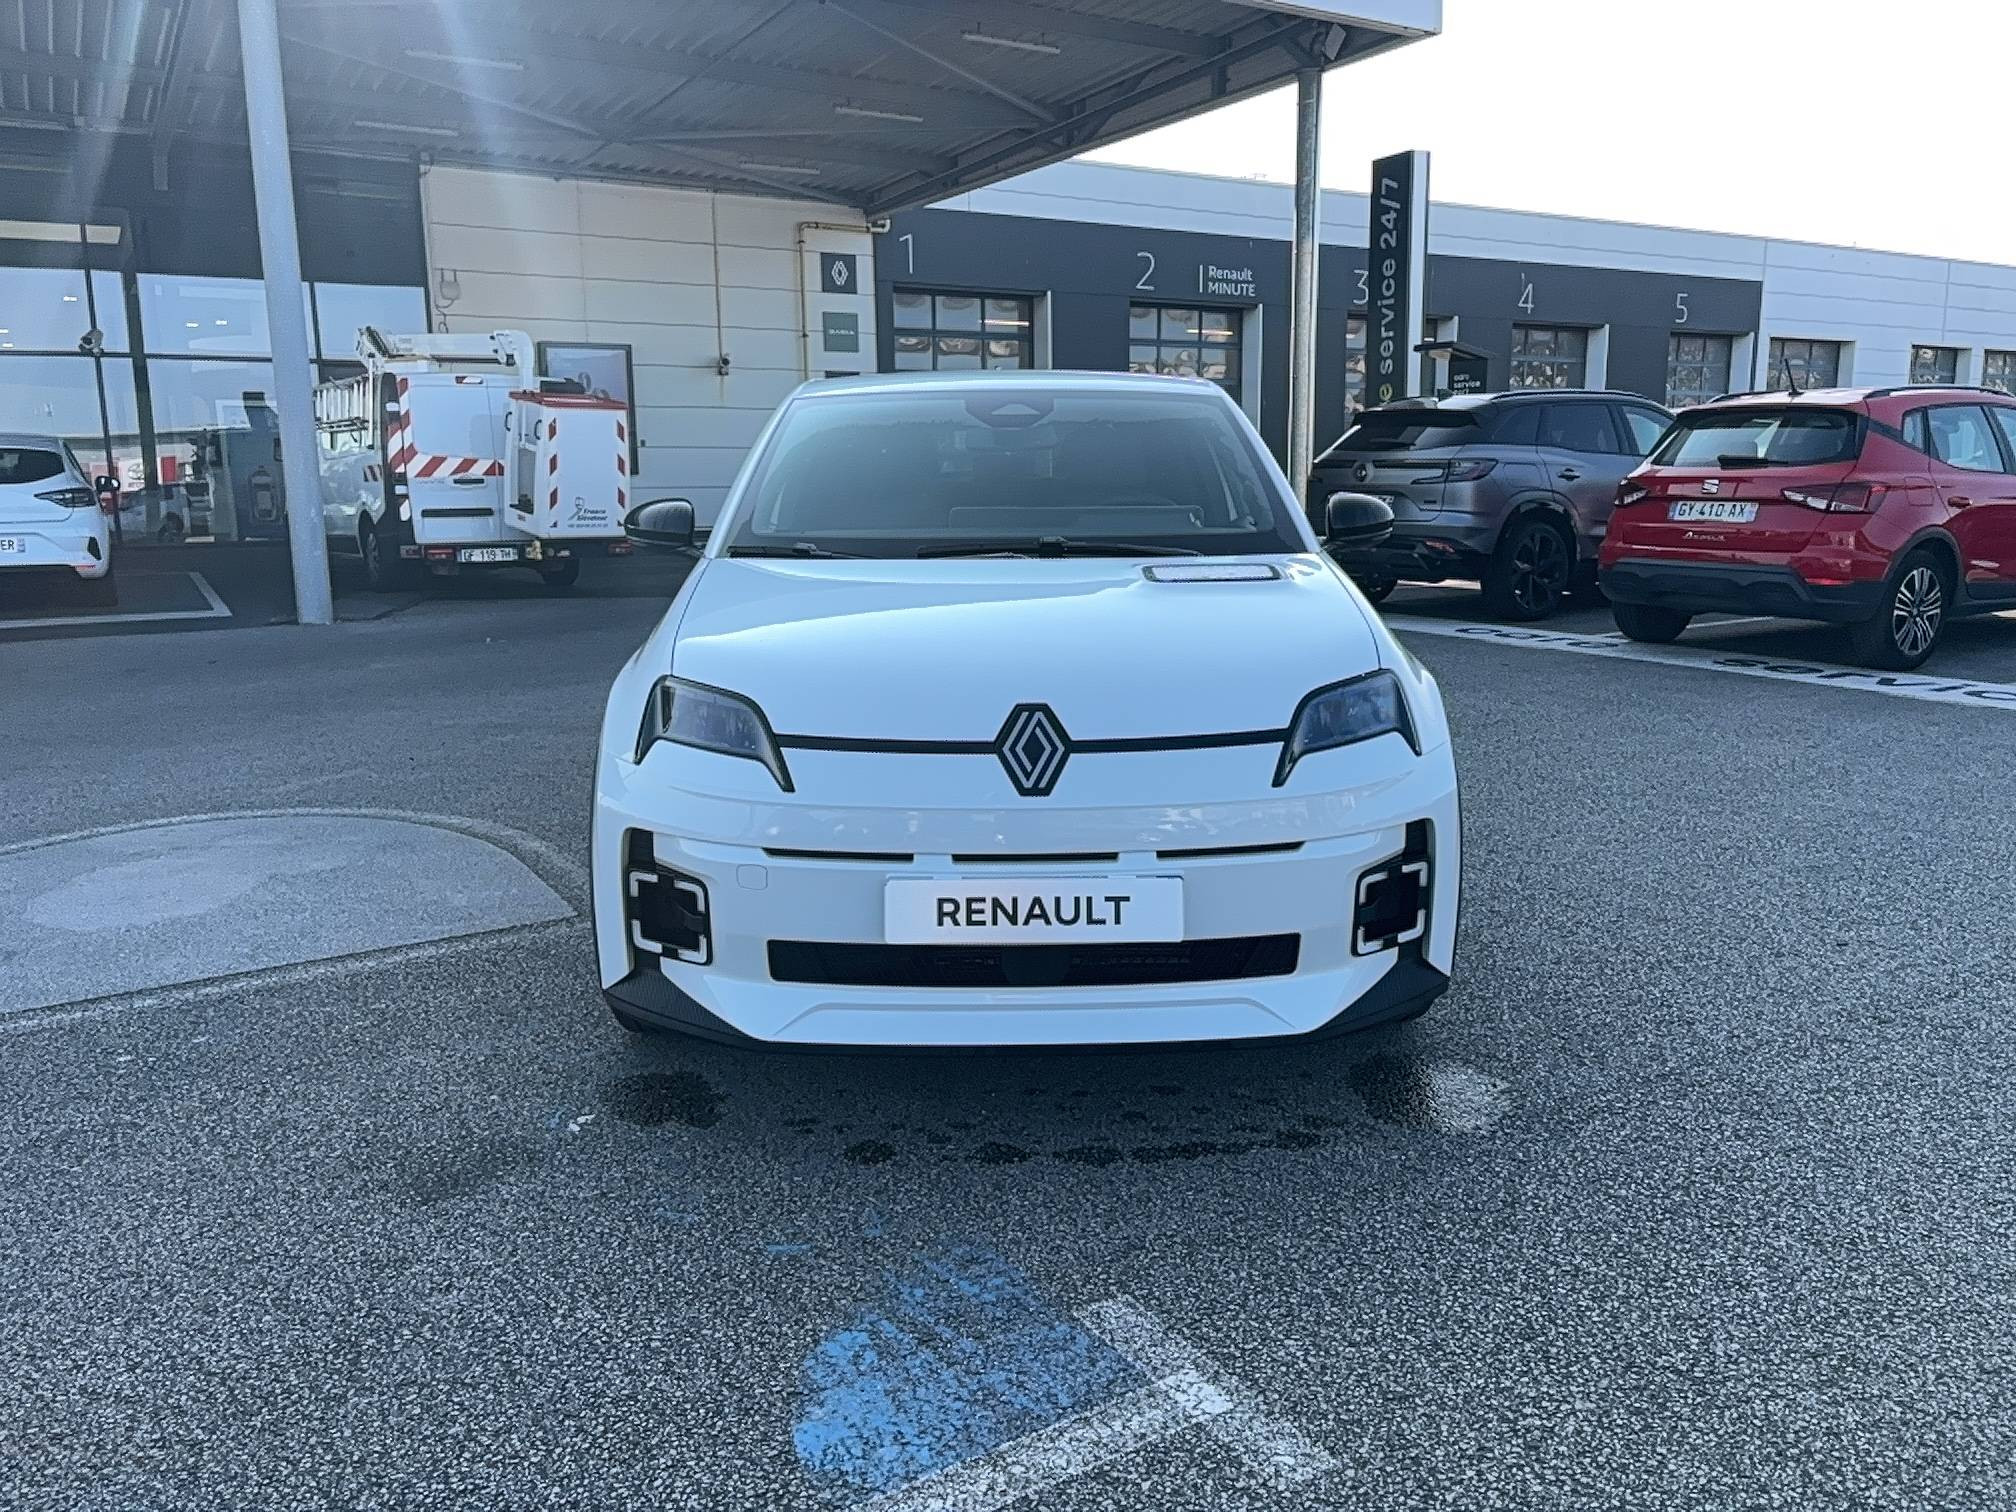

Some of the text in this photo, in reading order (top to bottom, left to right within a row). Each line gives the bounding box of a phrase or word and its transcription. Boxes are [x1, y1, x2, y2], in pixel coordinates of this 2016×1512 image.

[1380, 178, 1401, 250] 24/7
[899, 233, 913, 274] 1
[1136, 251, 1155, 291] 2
[1208, 265, 1253, 281] Renault
[1352, 269, 1369, 305] 3
[1208, 281, 1256, 297] MINUTE
[1518, 283, 1535, 315] 4
[1378, 258, 1396, 375] service
[1675, 293, 1689, 323] 5
[1455, 627, 1620, 649] care
[936, 896, 1131, 928] RENAULT
